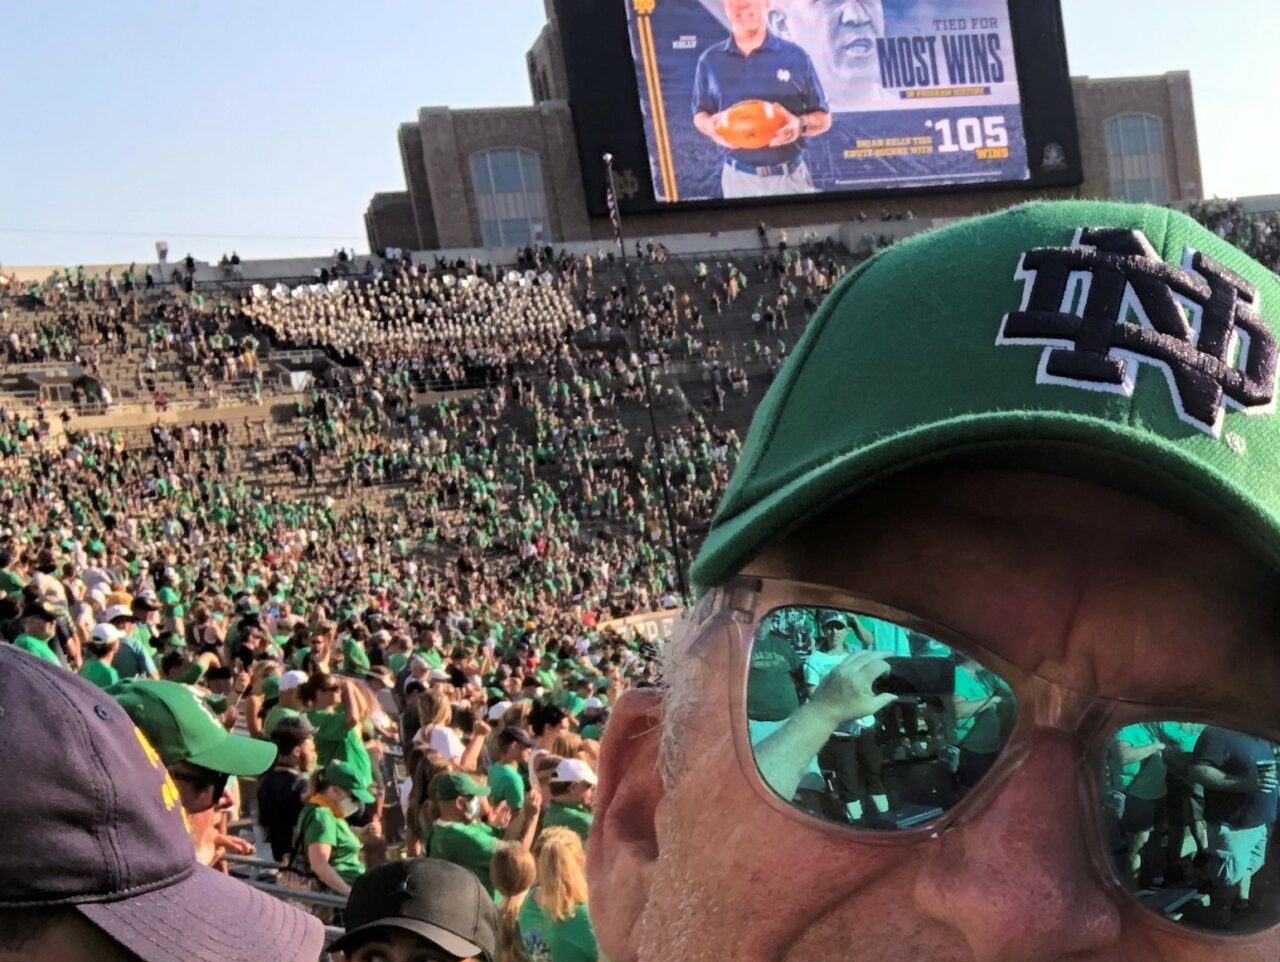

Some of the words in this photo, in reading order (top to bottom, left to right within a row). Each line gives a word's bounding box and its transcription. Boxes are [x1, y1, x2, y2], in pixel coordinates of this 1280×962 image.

[932, 18, 967, 31] TIED
[971, 17, 999, 30] FOR
[876, 36, 939, 88] MOST
[941, 33, 1005, 85] WINS
[994, 226, 1280, 440] ND
